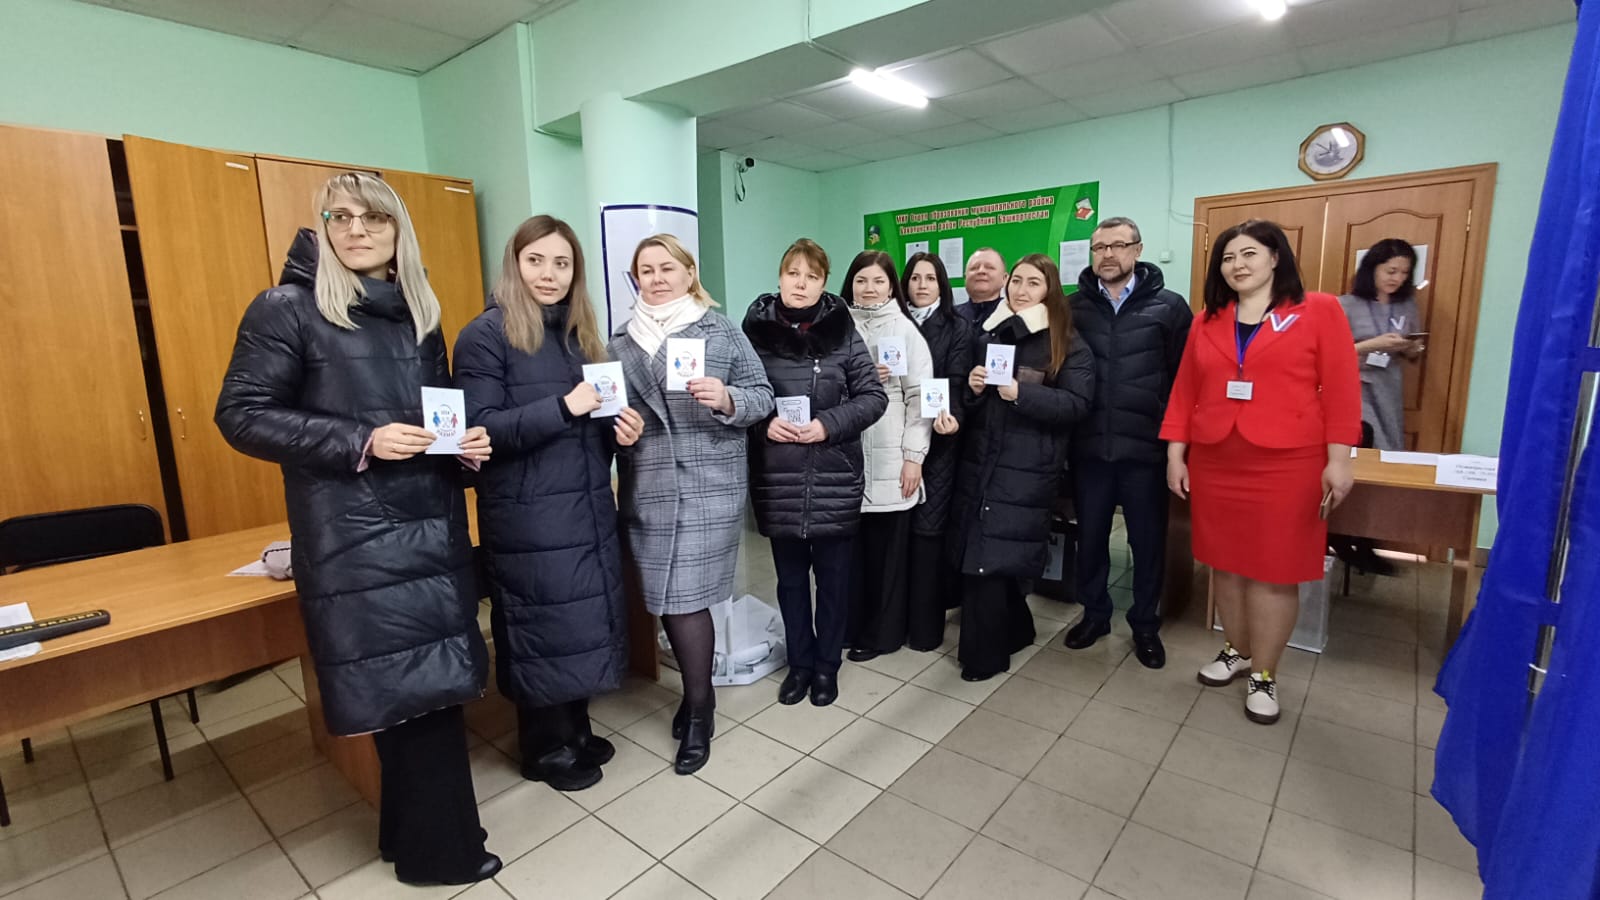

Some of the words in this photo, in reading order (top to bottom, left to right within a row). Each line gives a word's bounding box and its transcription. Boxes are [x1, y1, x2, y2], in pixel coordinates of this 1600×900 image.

[930, 207, 971, 221] образования
[971, 199, 1026, 215] муниципального
[1027, 195, 1054, 209] района
[938, 220, 958, 233] район
[958, 216, 996, 229] Республики
[997, 210, 1049, 224] Башкортостан
